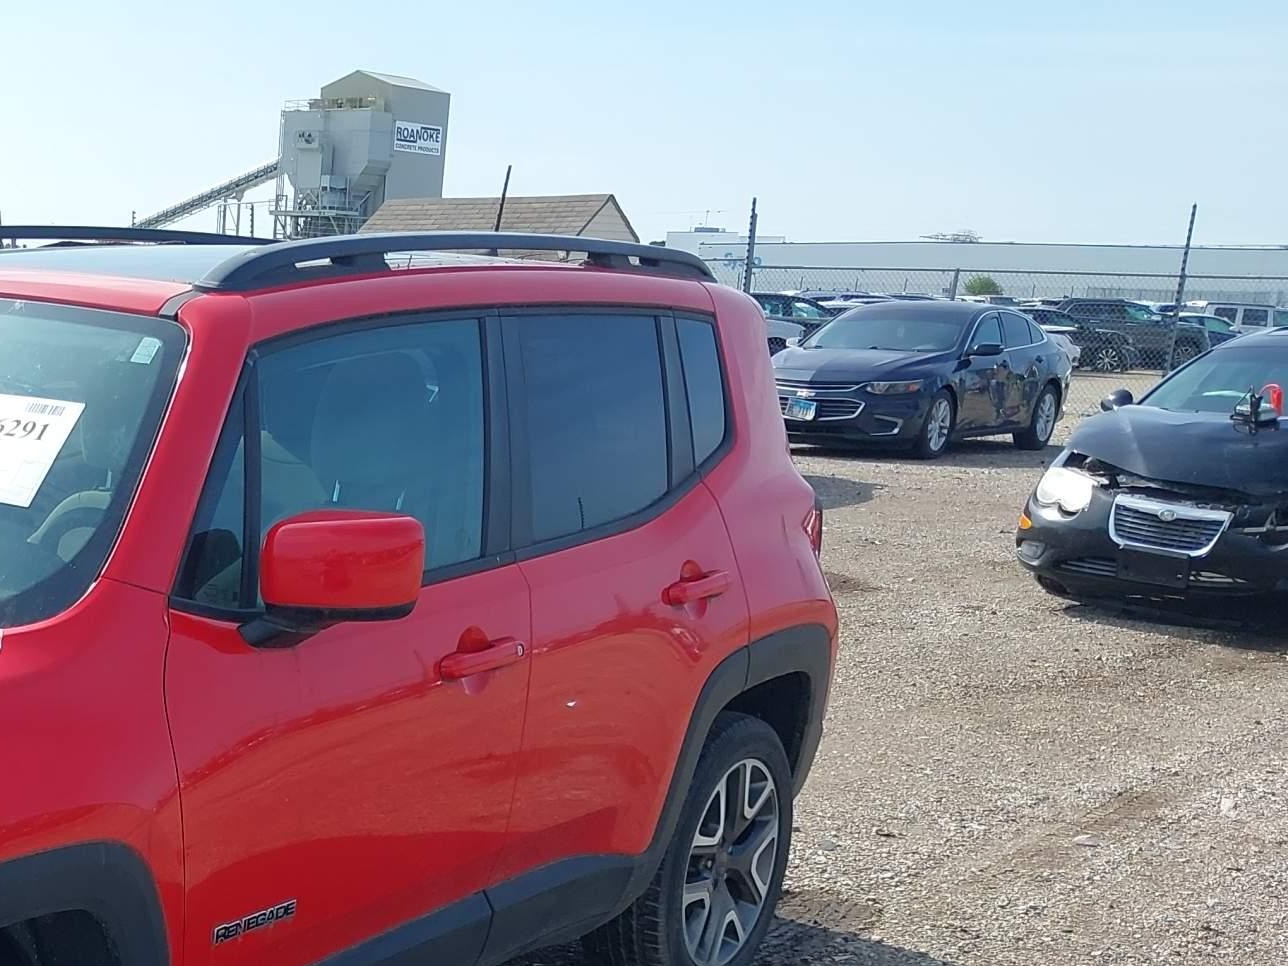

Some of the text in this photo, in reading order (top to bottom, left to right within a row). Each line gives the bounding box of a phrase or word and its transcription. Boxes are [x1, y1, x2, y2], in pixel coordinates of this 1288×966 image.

[396, 126, 441, 143] ROANOKE
[418, 146, 439, 154] PRODUCTS
[213, 899, 297, 945] RENEGADE
